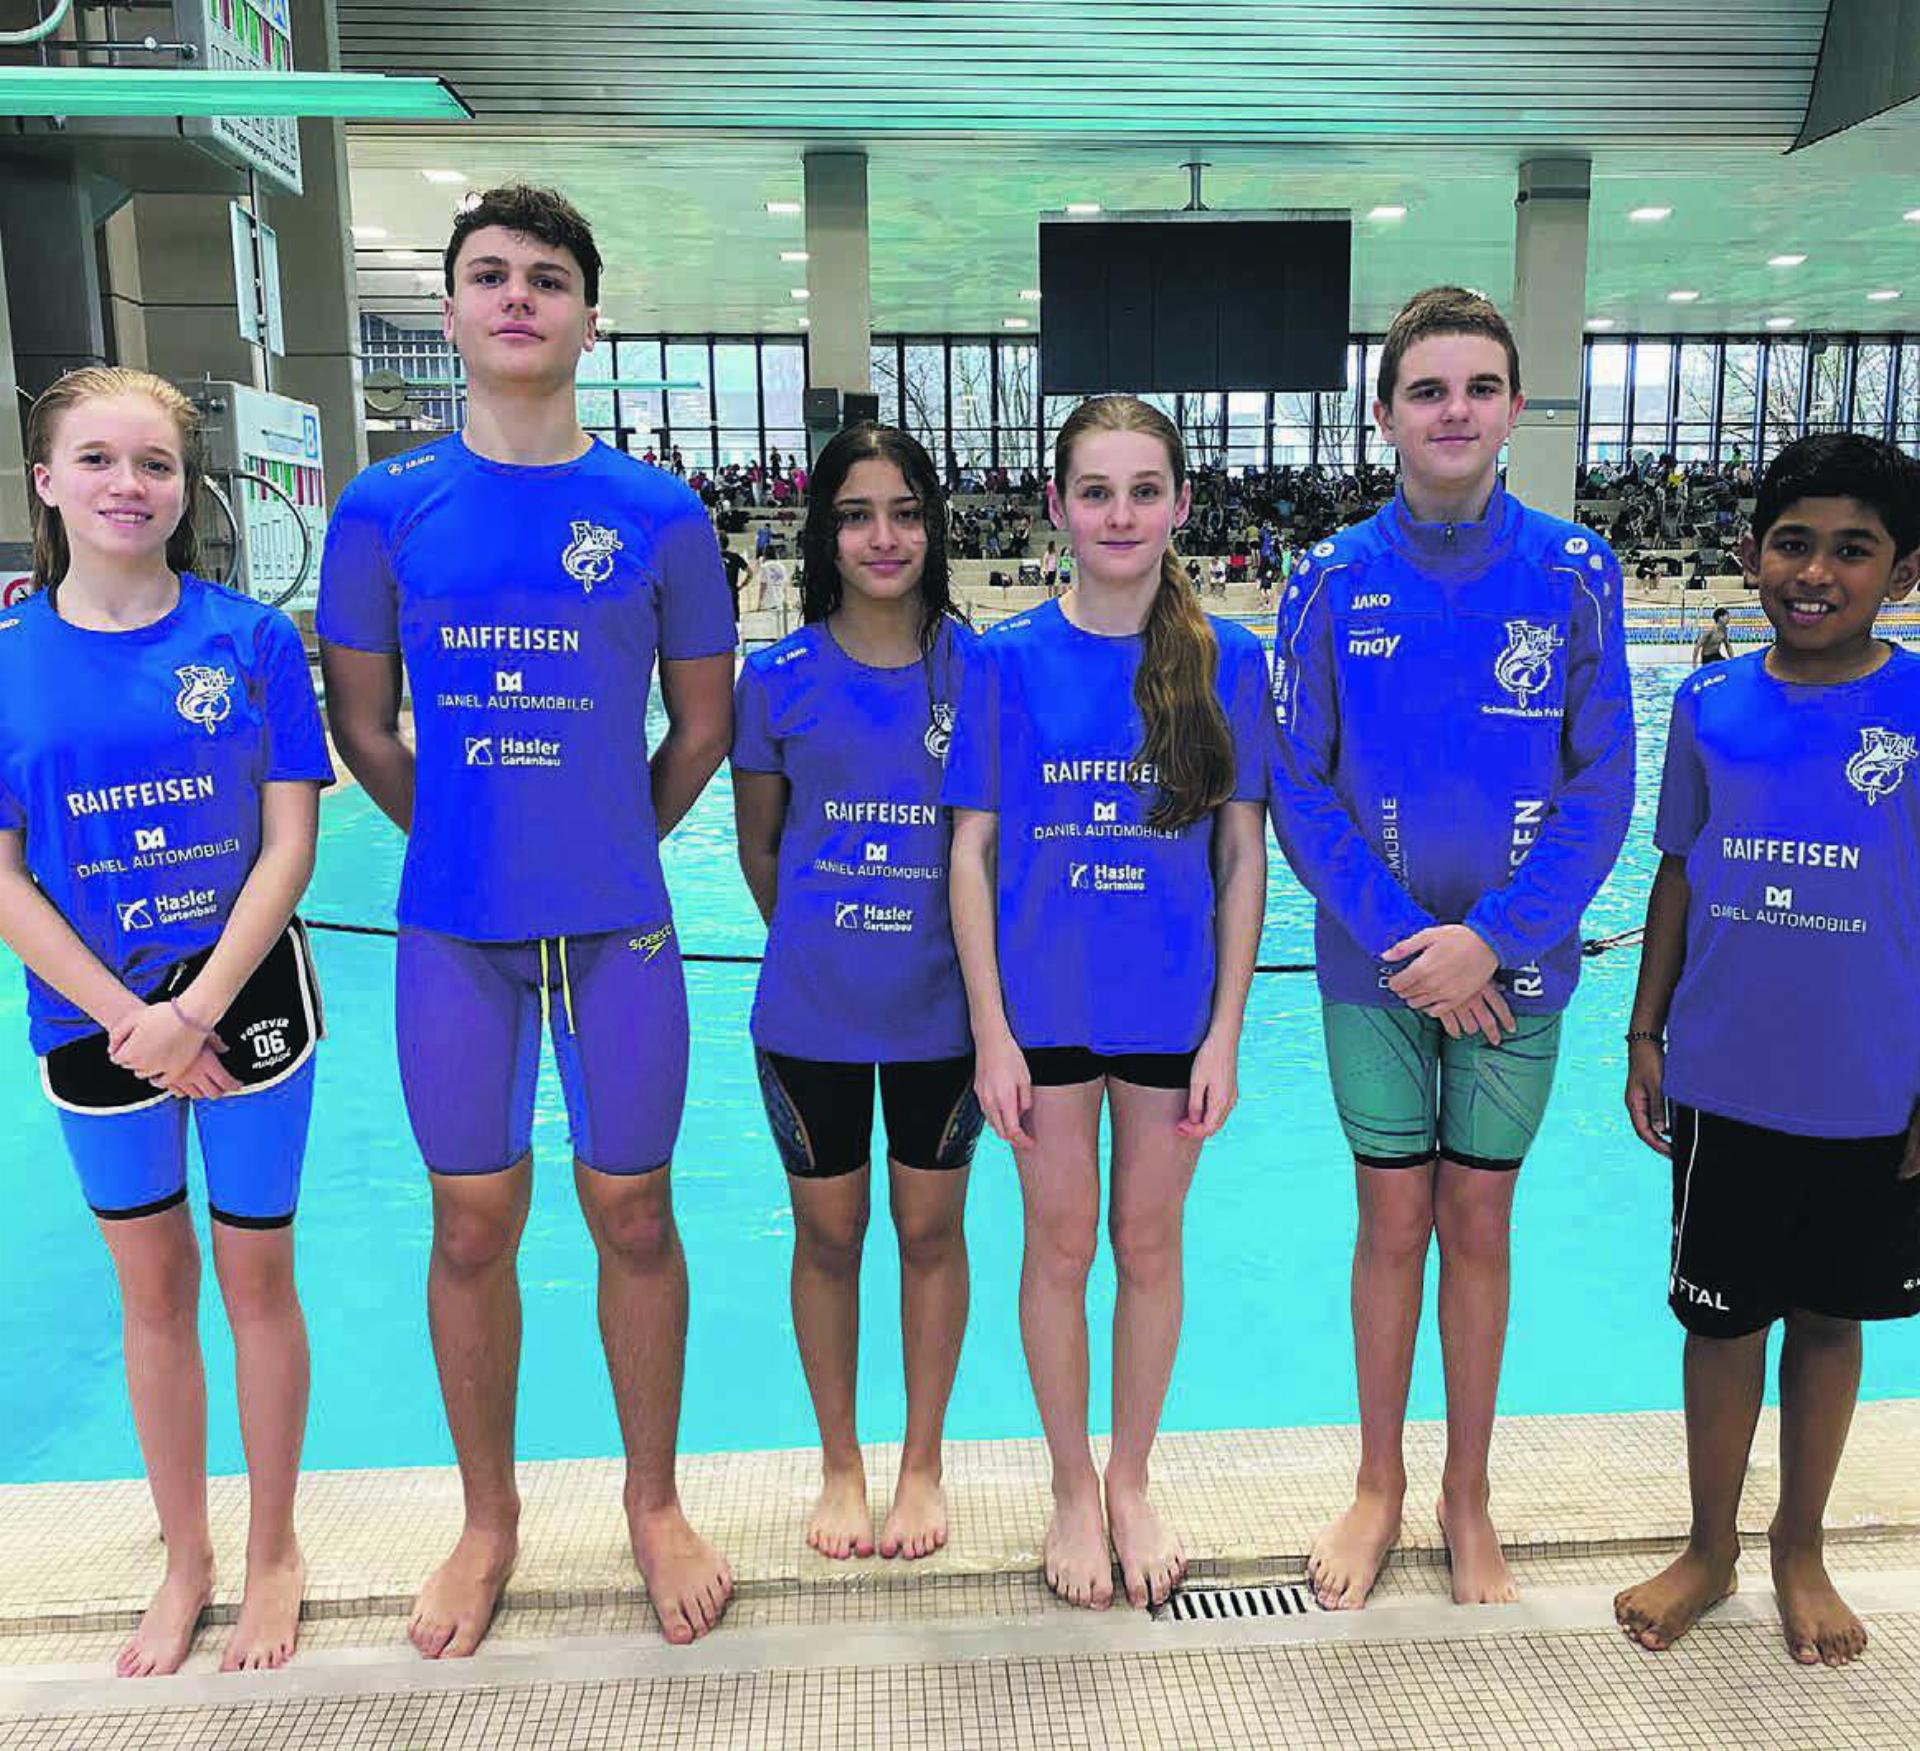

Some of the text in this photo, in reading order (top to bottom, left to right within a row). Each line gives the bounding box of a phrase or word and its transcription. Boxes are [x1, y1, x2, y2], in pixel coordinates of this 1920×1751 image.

[1351, 594, 1391, 610] JAKO
[440, 626, 579, 652] RAIFFEISEN
[1349, 634, 1401, 658] may
[501, 738, 561, 755] Hasler
[501, 756, 561, 767] Gartenbau
[67, 775, 214, 816] RAIFFEISEN
[824, 801, 936, 825] RAIFFEISEN
[1034, 824, 1081, 840] DANIEL
[1722, 838, 1861, 869] RAIFFEISEN
[1094, 864, 1145, 880] Hasler
[154, 889, 216, 913] Hasler
[159, 904, 217, 924] Gartenbau
[864, 904, 912, 921] Hasler
[254, 1029, 286, 1057] 06
